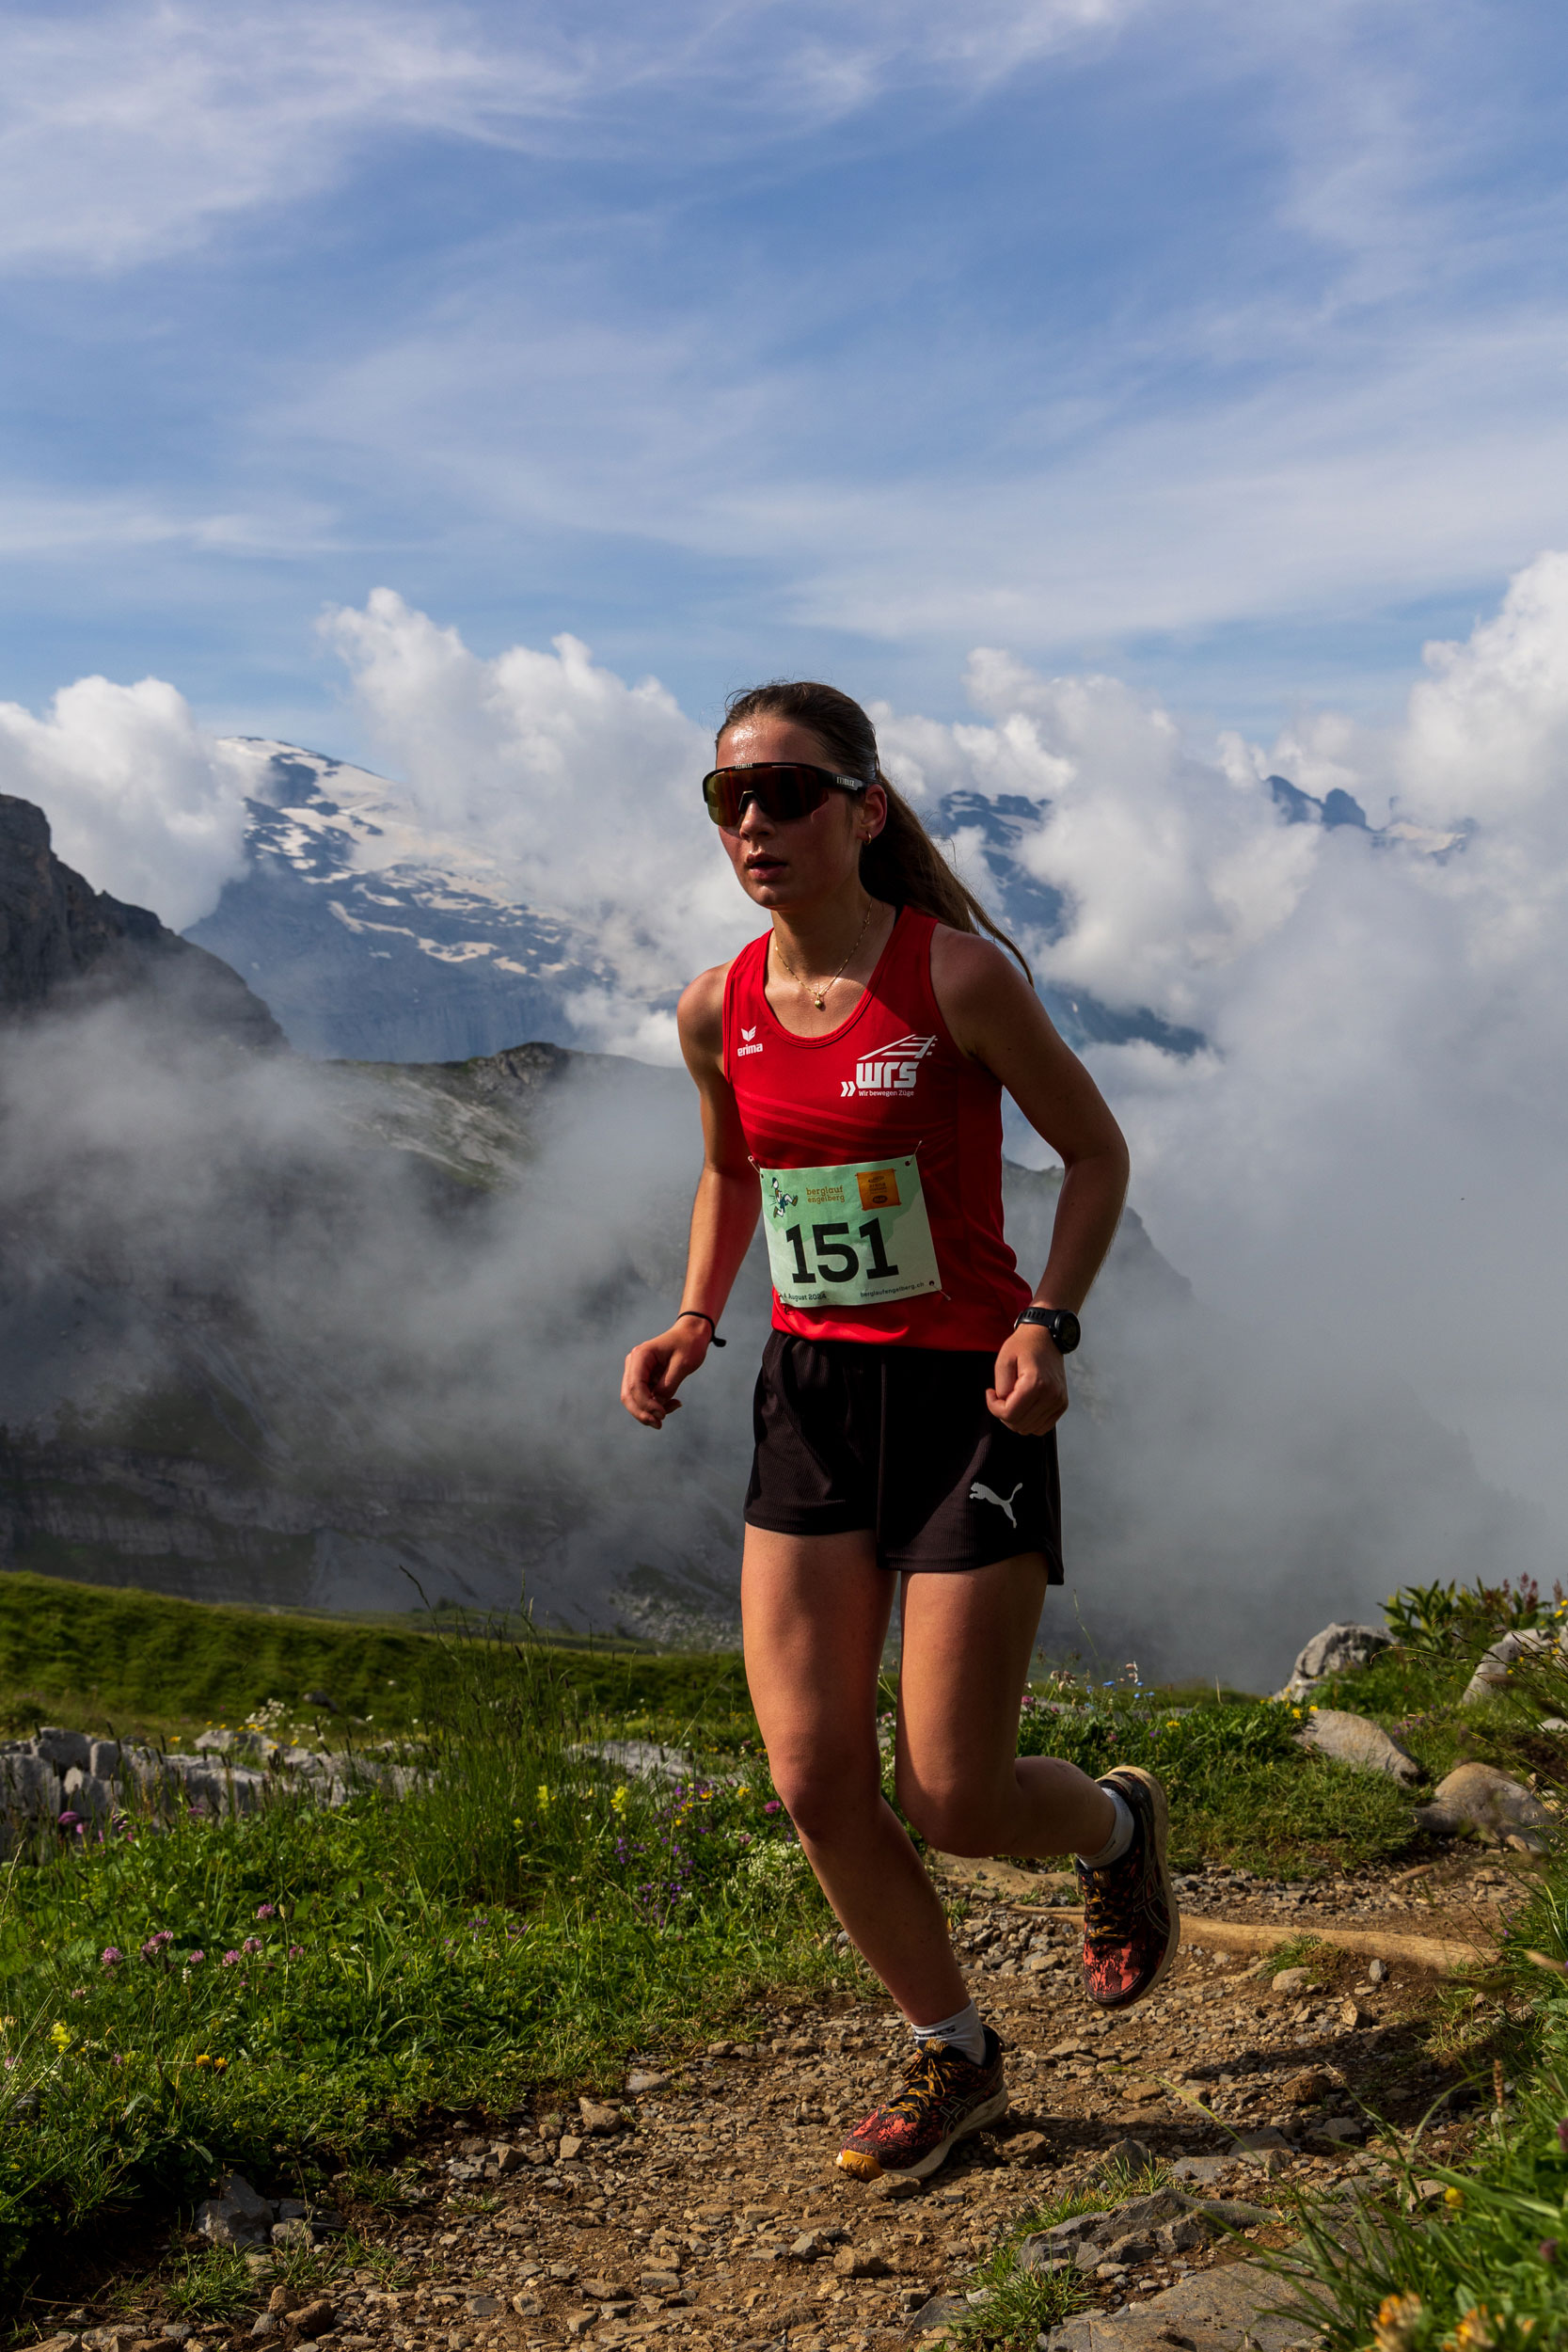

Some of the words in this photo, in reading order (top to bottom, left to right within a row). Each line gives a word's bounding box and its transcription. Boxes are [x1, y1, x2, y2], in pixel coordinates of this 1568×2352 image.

[736, 1043, 763, 1057] erima
[898, 1089, 914, 1098] Züge
[805, 1184, 843, 1196] berglauf
[807, 1195, 846, 1204] engelberg
[785, 1217, 899, 1283] 151
[860, 1281, 925, 1297] berglaufengelberg.ch
